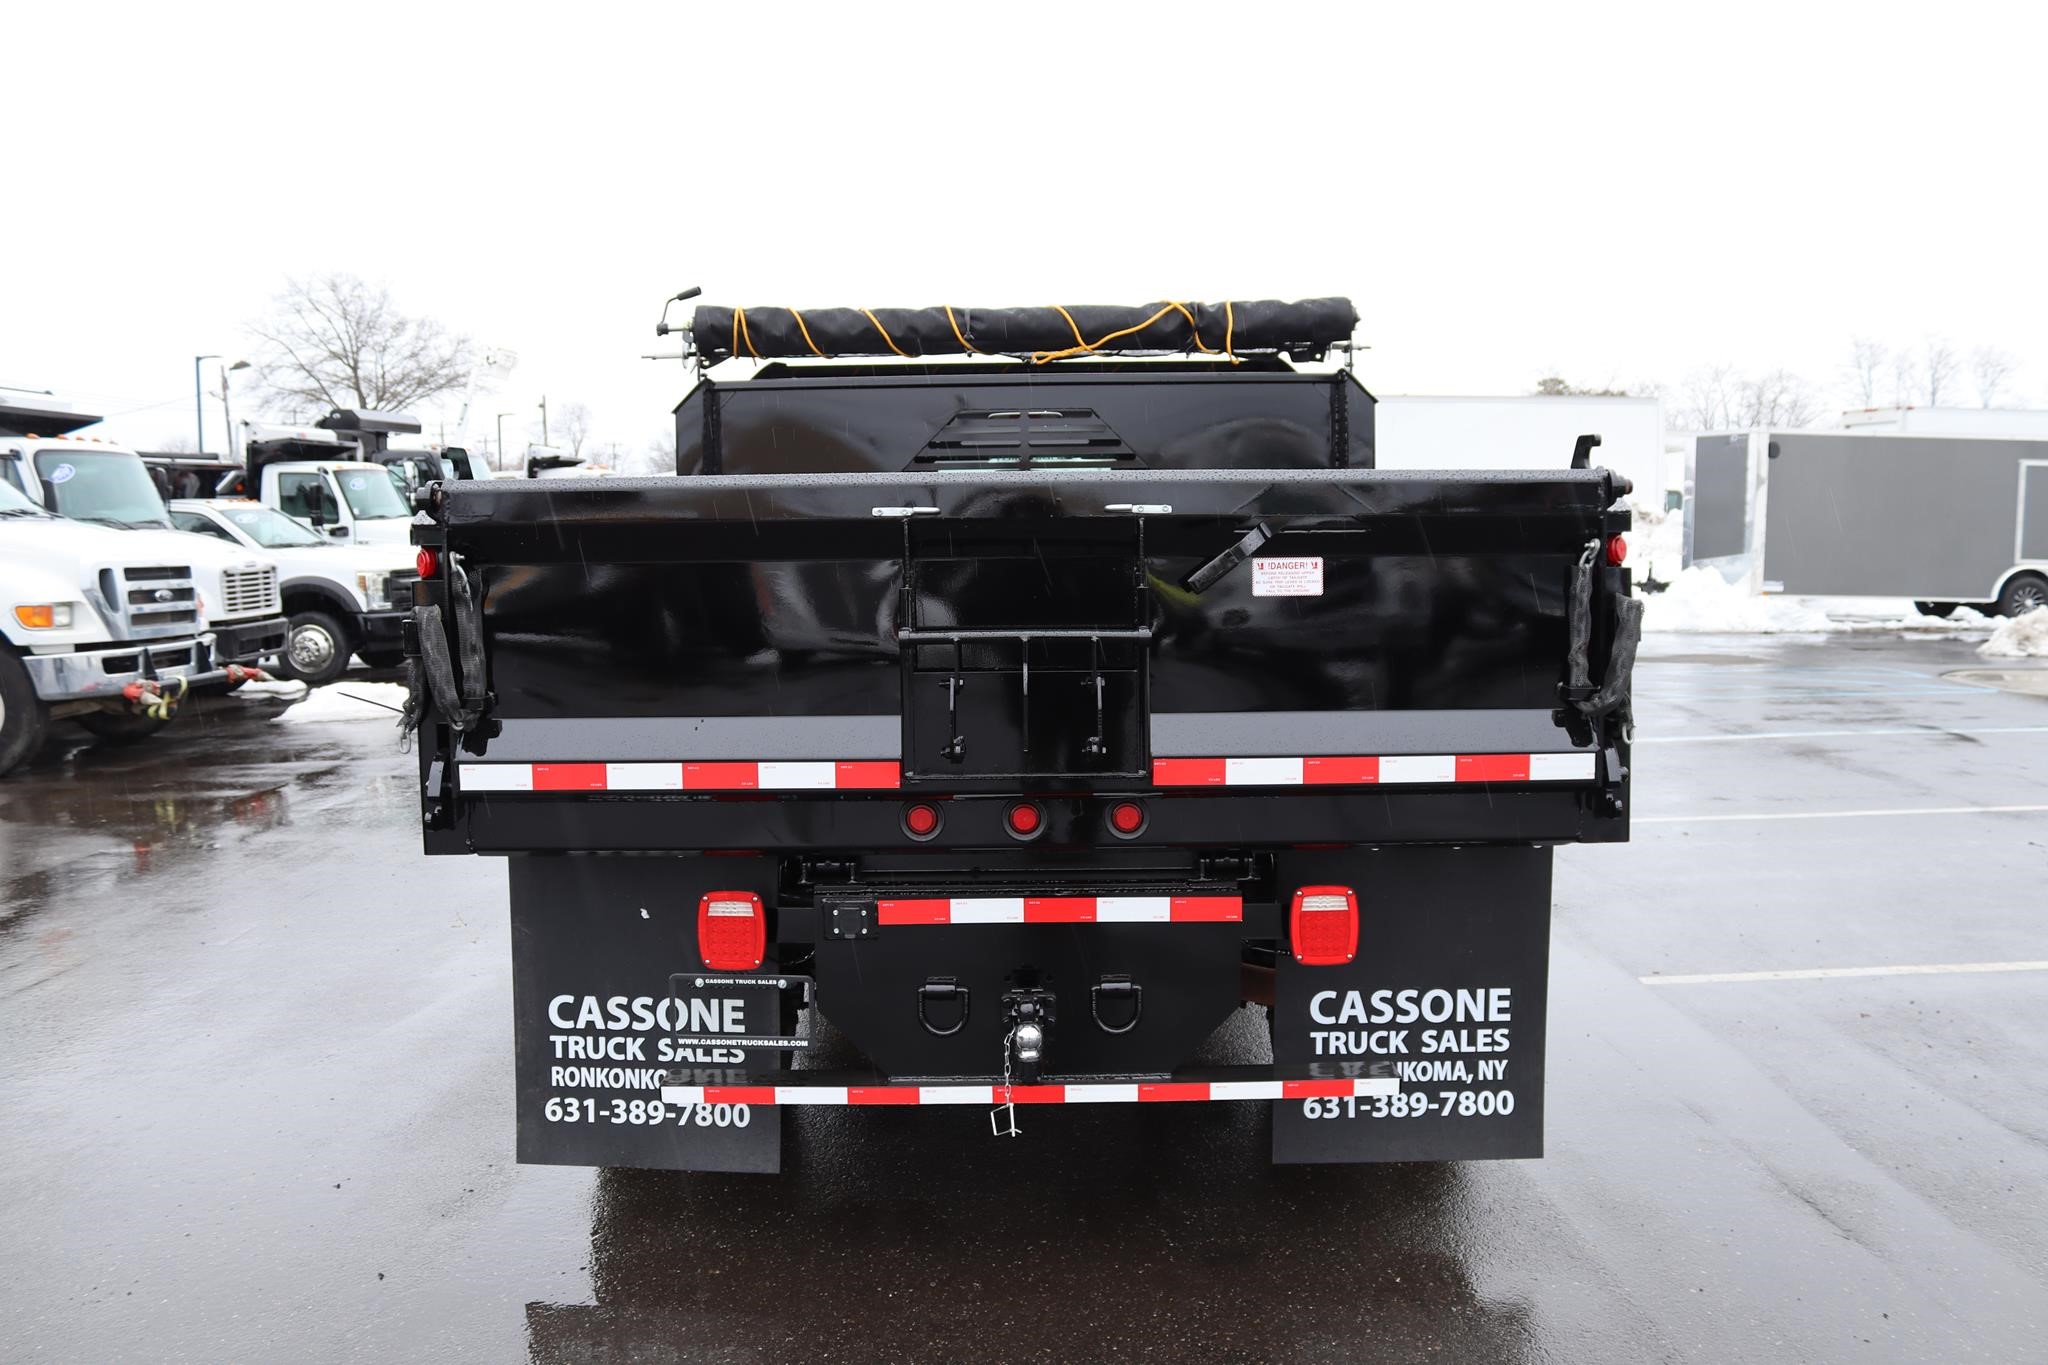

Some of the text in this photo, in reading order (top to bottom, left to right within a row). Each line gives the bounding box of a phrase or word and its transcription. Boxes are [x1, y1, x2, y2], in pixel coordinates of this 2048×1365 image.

[548, 994, 746, 1033] CASSONE
[1309, 987, 1512, 1025] CASSONE
[550, 1036, 646, 1062] TRUCK
[677, 1038, 809, 1048] WWW.CASSONETRUCKSALES.COM
[1309, 1028, 1511, 1055] TRUCK SALES
[1478, 1060, 1509, 1081] NY
[544, 1097, 751, 1128] 631-389-7800
[1303, 1090, 1515, 1120] 631-389-7800
